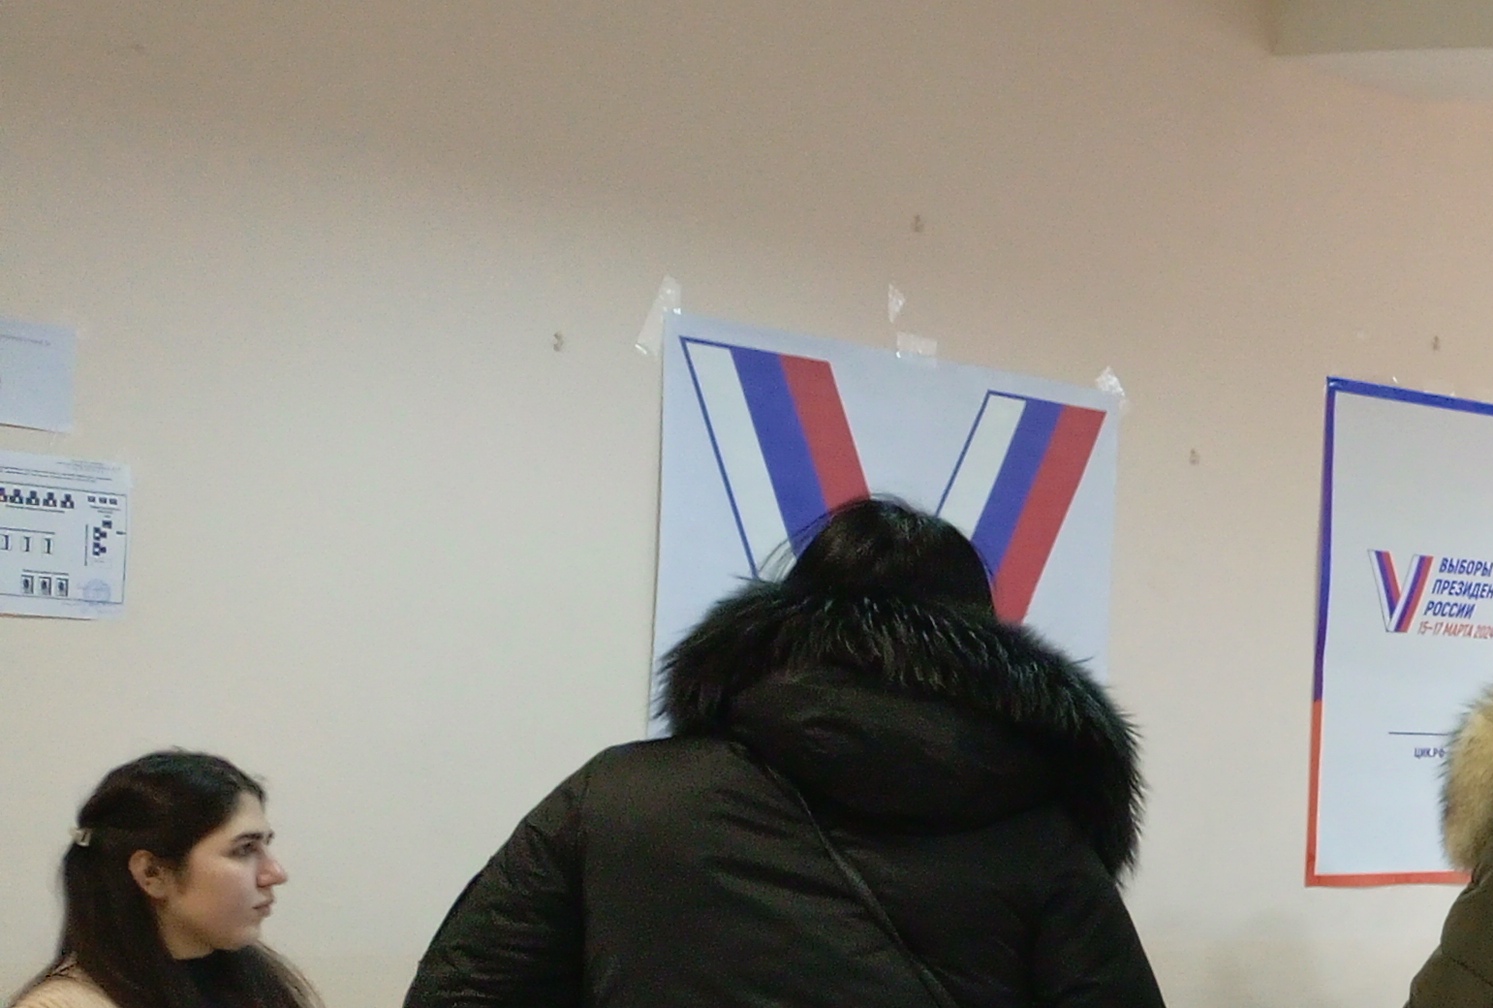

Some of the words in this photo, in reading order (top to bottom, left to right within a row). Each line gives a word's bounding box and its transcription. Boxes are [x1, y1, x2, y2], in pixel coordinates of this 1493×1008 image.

[1439, 557, 1493, 577] ВЫБОРЫ
[1423, 601, 1476, 619] РОССИИ
[1443, 623, 1473, 637] МАРТА
